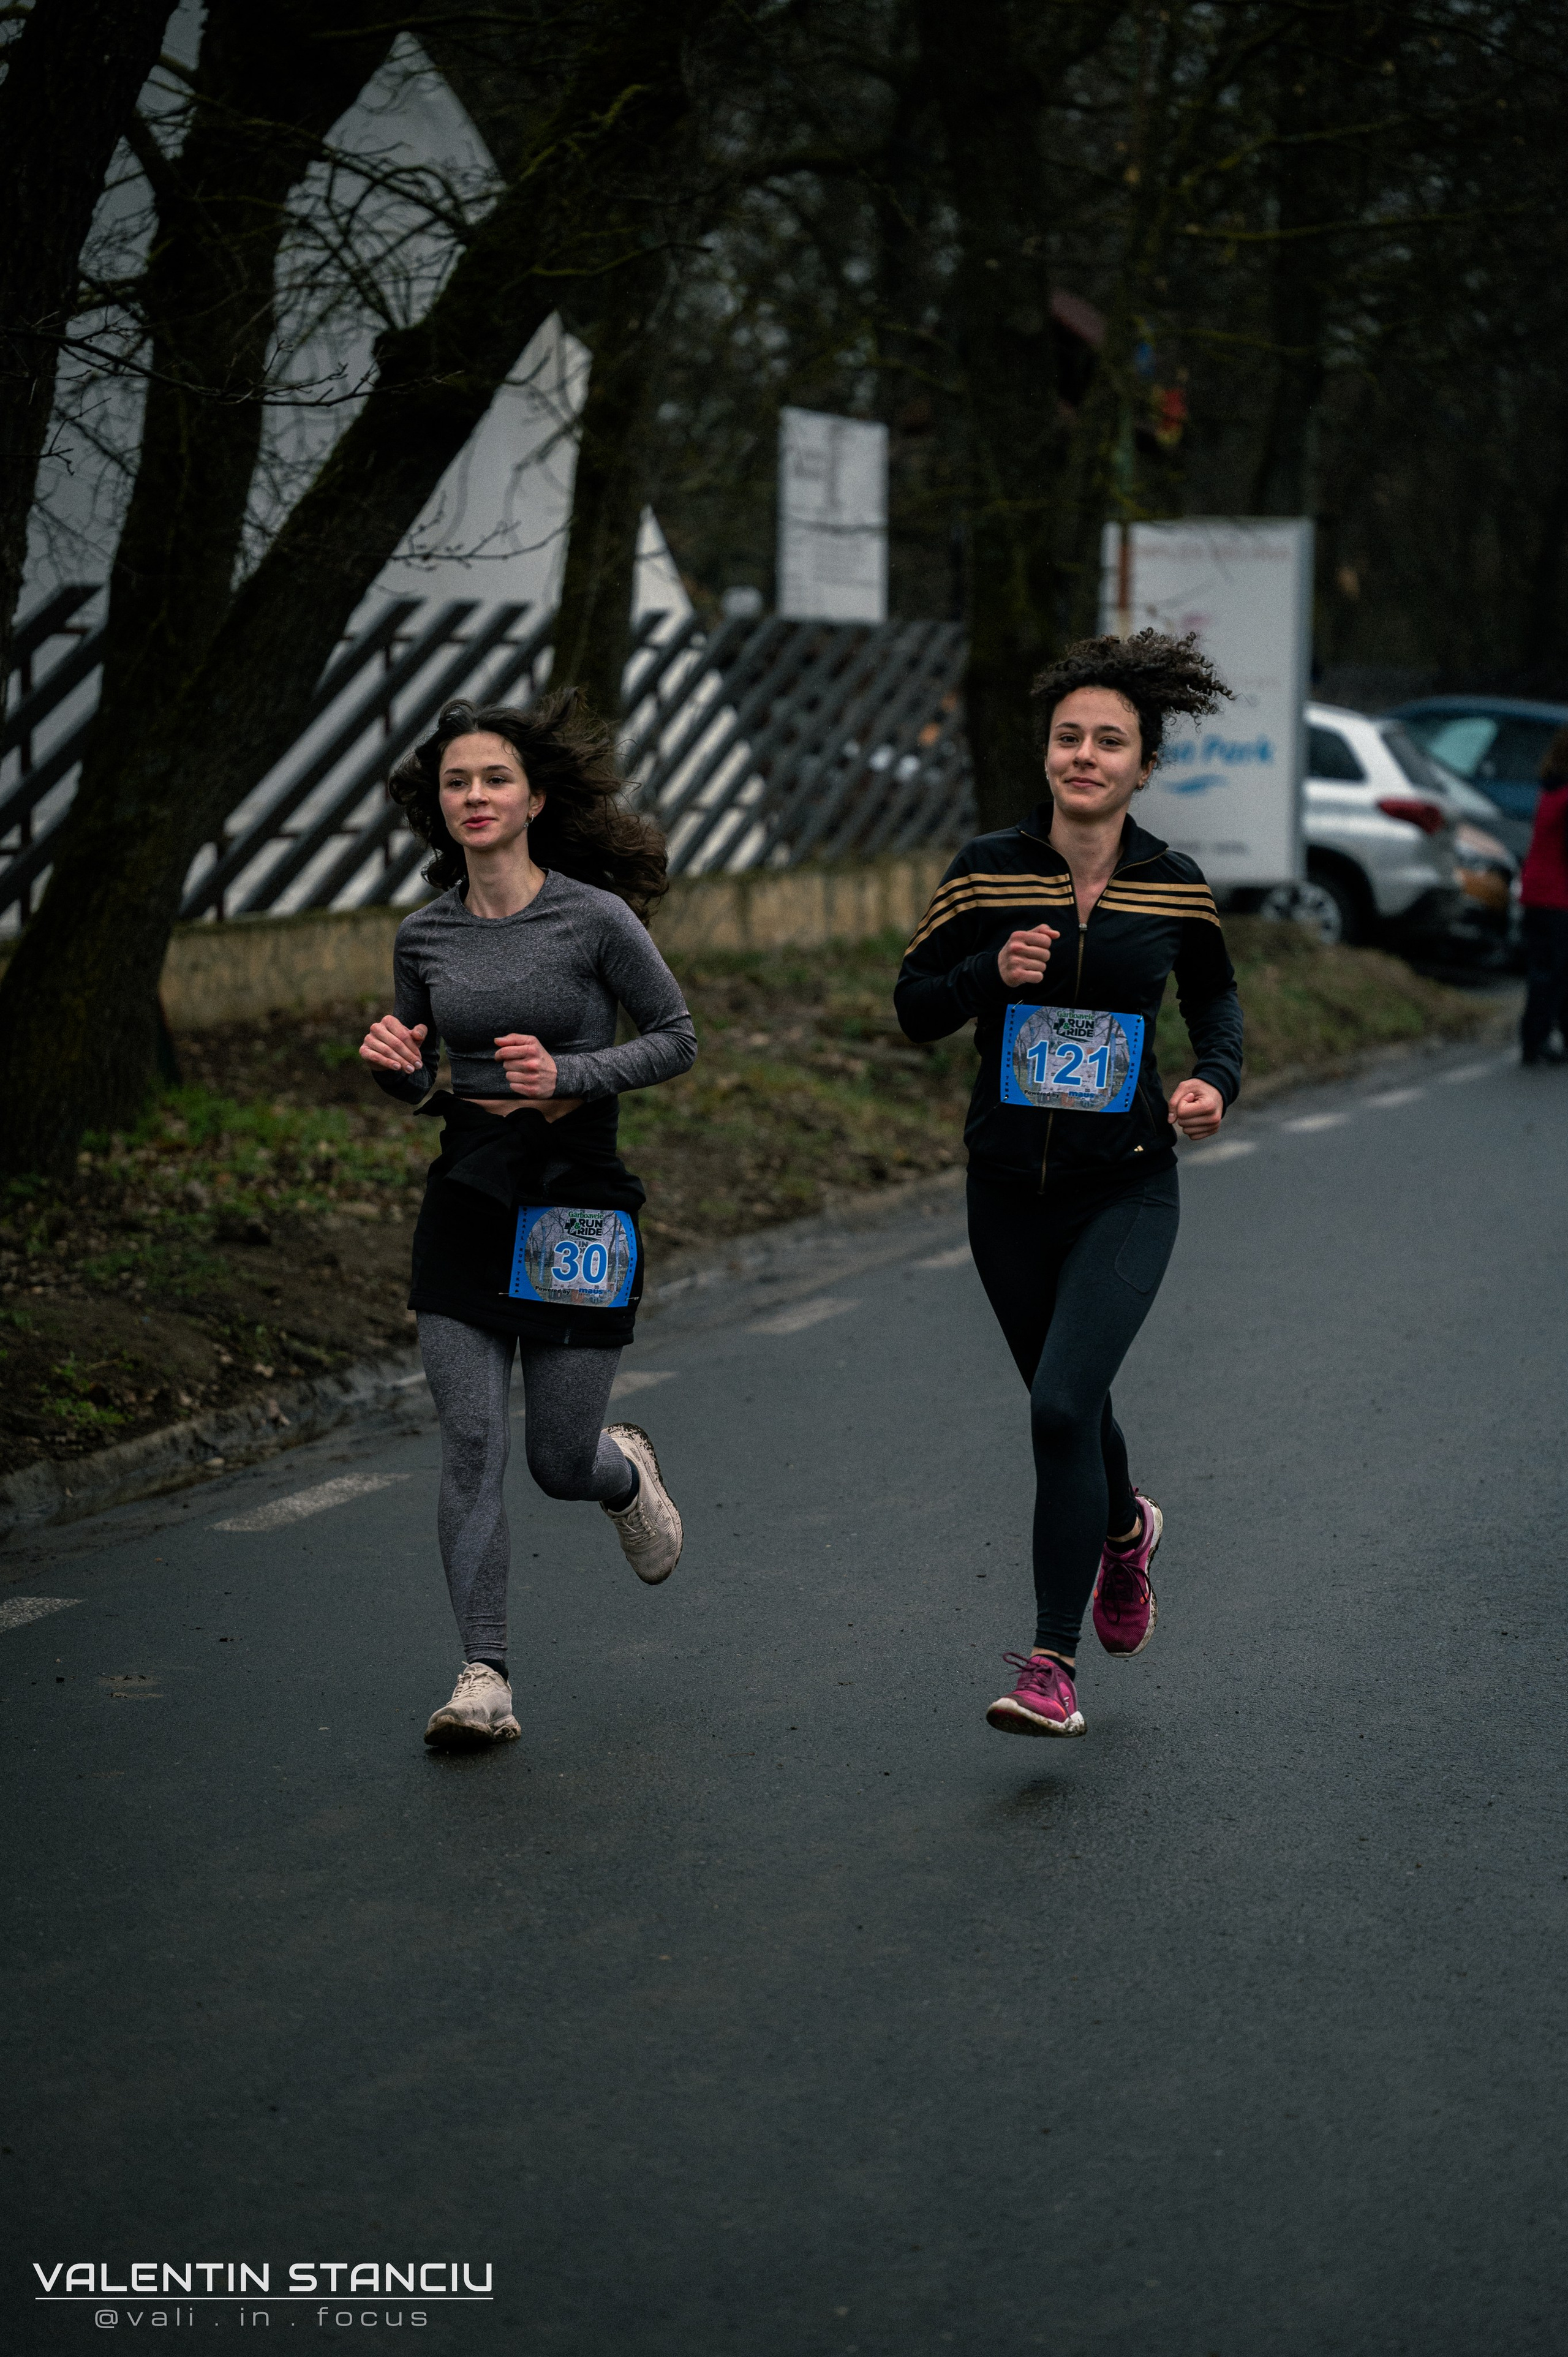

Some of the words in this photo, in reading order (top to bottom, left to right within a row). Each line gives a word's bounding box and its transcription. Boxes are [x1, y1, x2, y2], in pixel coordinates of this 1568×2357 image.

[1068, 1019, 1094, 1029] RUN
[1067, 1028, 1093, 1038] RIDE
[1027, 1040, 1110, 1089] 121
[579, 1218, 603, 1228] RUN
[577, 1228, 602, 1236] RIDE
[551, 1240, 608, 1283] 30
